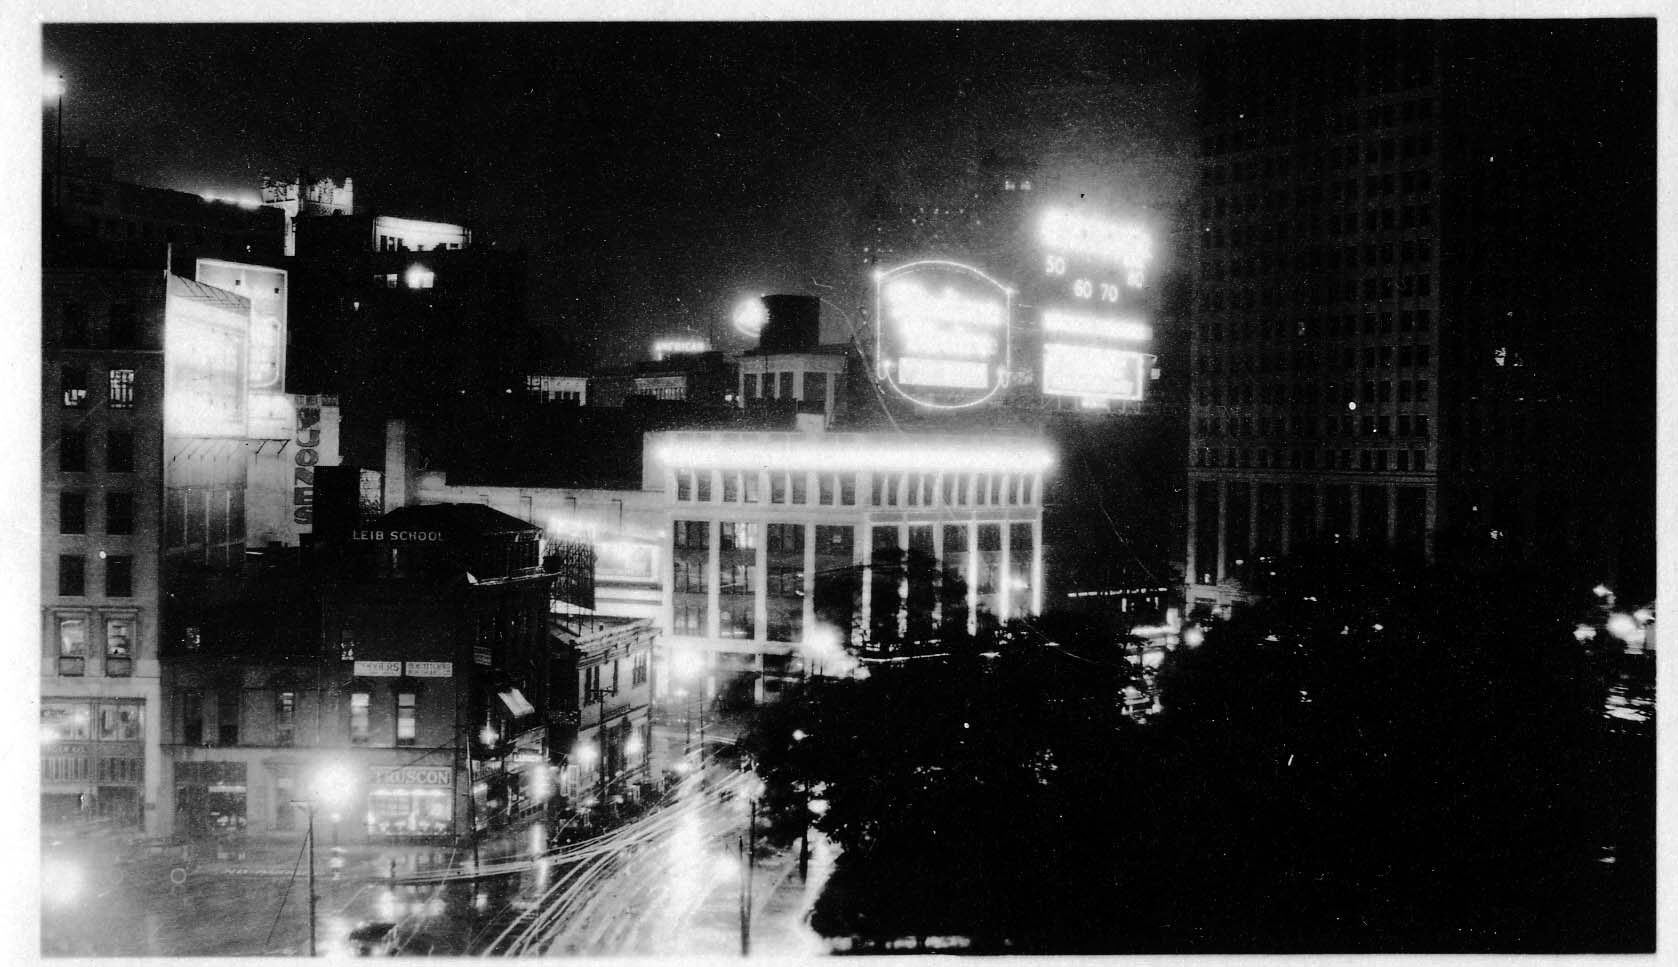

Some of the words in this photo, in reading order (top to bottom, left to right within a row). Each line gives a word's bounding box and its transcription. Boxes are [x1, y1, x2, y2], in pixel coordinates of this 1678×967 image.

[1045, 255, 1065, 274] 50
[1073, 279, 1092, 299] 60
[1100, 282, 1119, 302] 70
[352, 529, 384, 541] LEIB
[390, 530, 444, 542] SCHOOL
